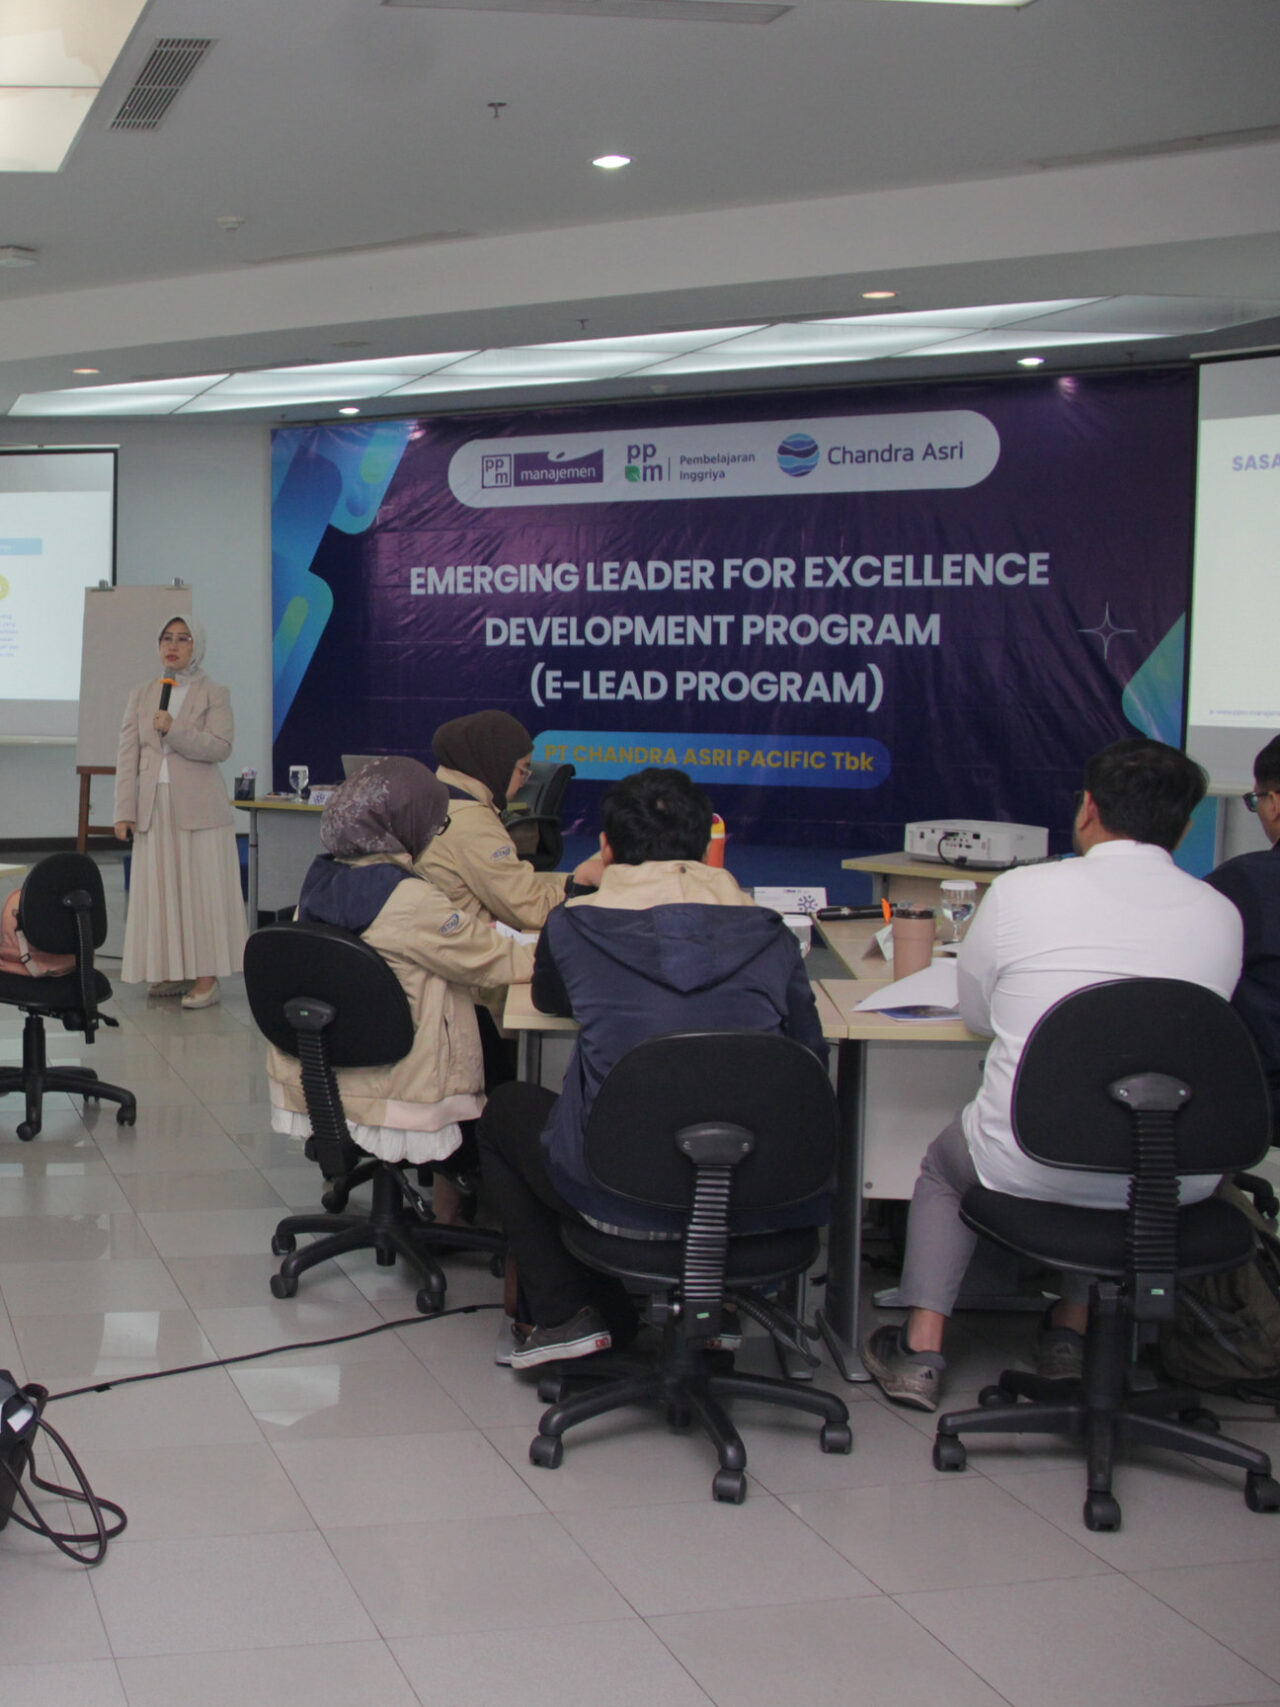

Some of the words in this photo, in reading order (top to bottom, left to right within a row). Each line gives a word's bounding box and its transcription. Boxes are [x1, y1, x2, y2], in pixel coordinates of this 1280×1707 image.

[679, 452, 756, 467] Pembelajaran
[827, 443, 915, 465] Chandra
[922, 441, 964, 461] Asri
[520, 465, 596, 483] manajemen
[679, 469, 726, 482] Inggriya
[410, 562, 580, 595] EMERGING
[586, 559, 715, 592] LEADER
[723, 557, 797, 589] FOR
[804, 552, 1050, 588] EXCELLENCE
[485, 615, 735, 646] DEVELOPMENT
[742, 613, 941, 646] PROGRAM
[530, 662, 669, 707] (E-LEAD
[675, 663, 884, 712] PROGRAM)
[544, 745, 567, 762] PT
[573, 746, 678, 765] CHANDRA
[683, 748, 732, 767] ASRI
[737, 749, 827, 769] PACIFIC
[831, 752, 874, 771] Tbk
